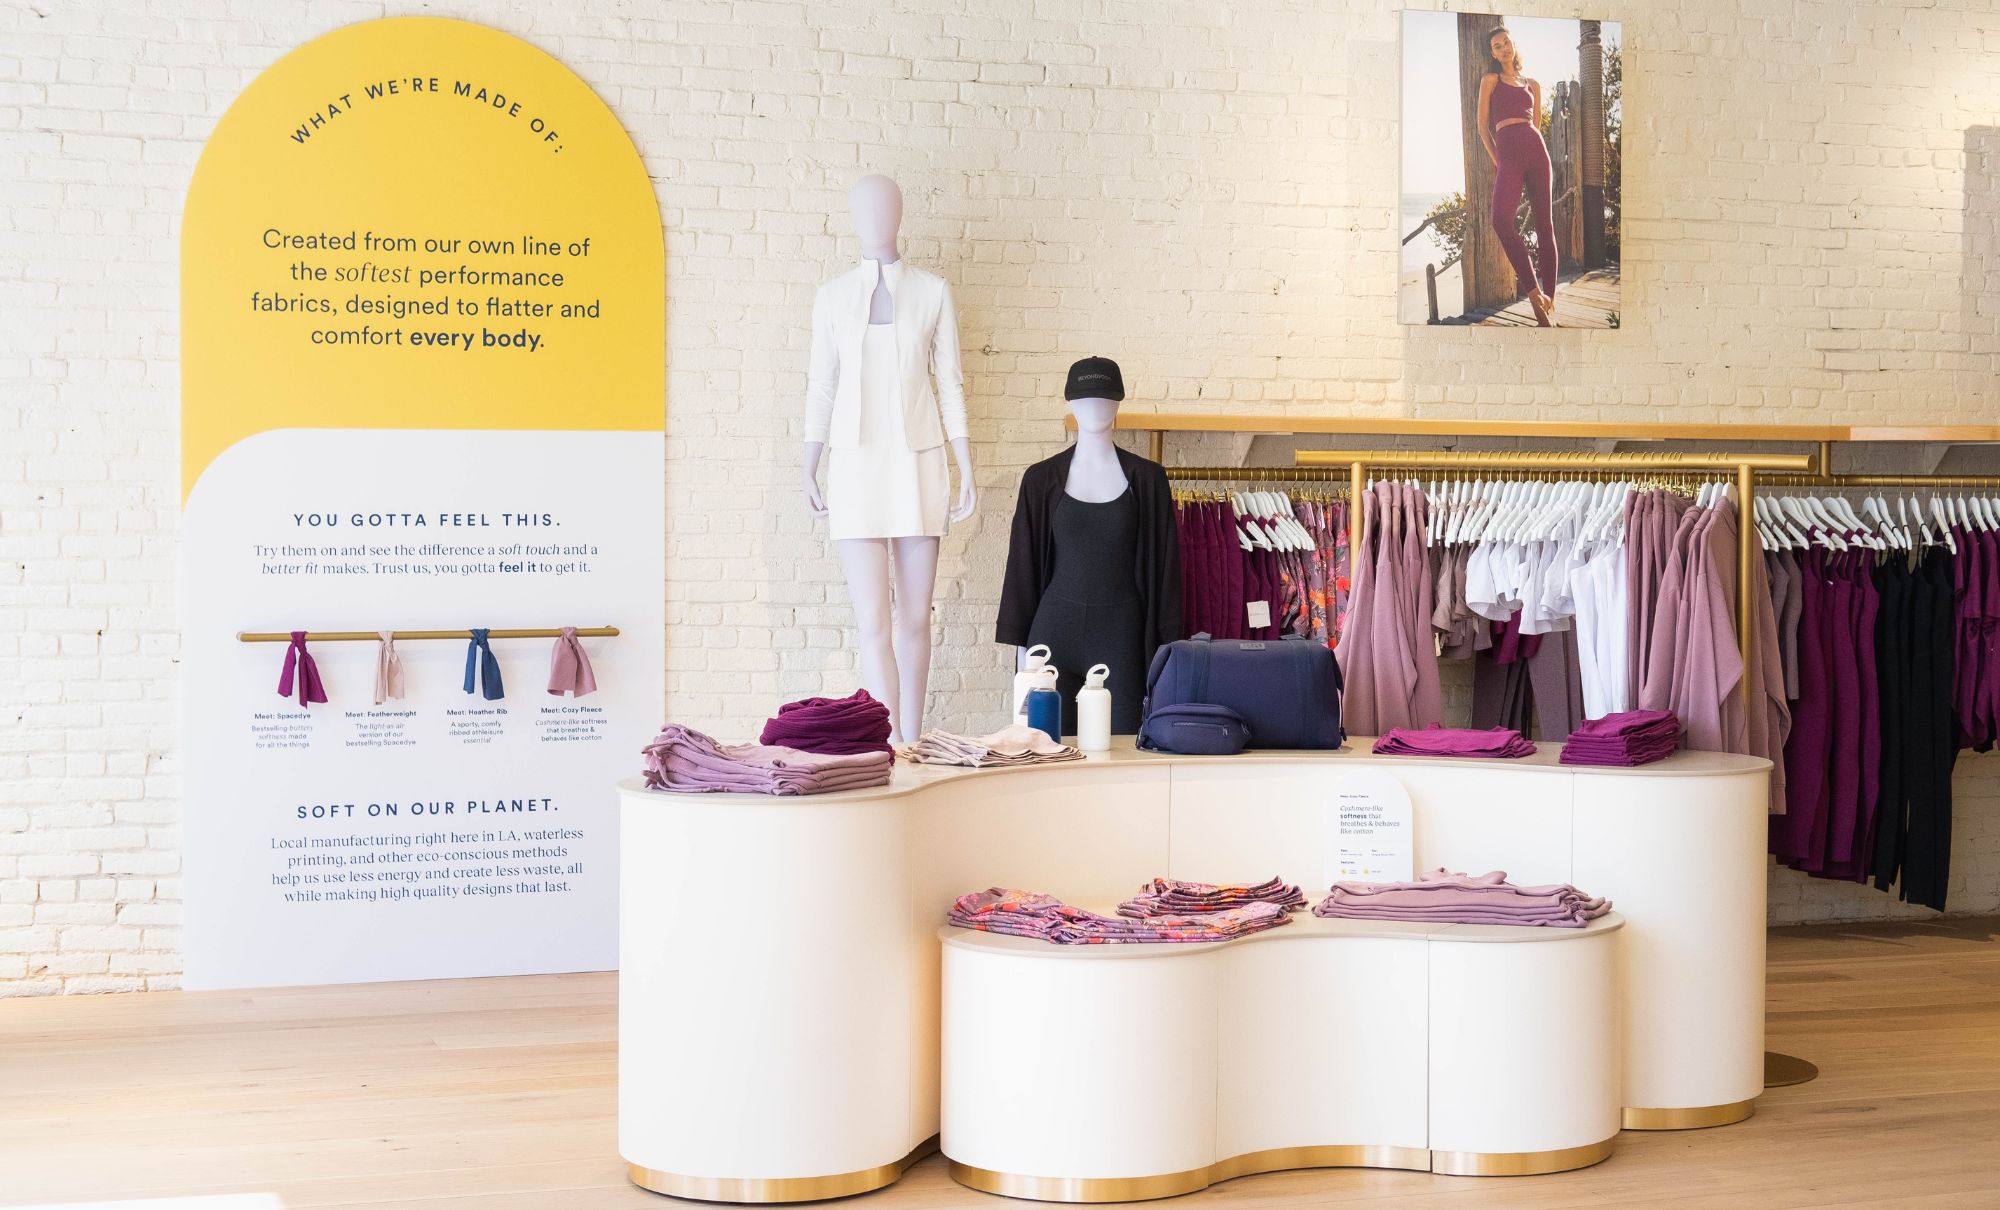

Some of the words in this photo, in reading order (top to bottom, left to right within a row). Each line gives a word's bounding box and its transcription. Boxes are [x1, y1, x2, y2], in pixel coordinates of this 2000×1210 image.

[291, 94, 351, 143] WHAT
[364, 78, 438, 99] WE'RE
[454, 81, 522, 117] MADE
[530, 119, 562, 153] OF:
[263, 229, 355, 250] Created
[364, 232, 416, 252] from
[425, 239, 461, 253] our
[469, 240, 514, 254] own
[524, 236, 561, 256] line
[569, 238, 590, 256] of
[290, 261, 327, 281] the
[335, 262, 412, 283] softest
[420, 265, 563, 288] performance
[252, 292, 337, 316] fabrics,
[346, 294, 448, 319] designed
[457, 299, 478, 316] to
[486, 297, 553, 317] flatter
[561, 299, 599, 318] and
[311, 326, 402, 345] comfort
[410, 332, 475, 351] every
[483, 328, 544, 352] body.
[294, 514, 337, 526] YOU
[351, 514, 426, 526] GOTTA
[440, 514, 489, 526] FEEL
[502, 514, 560, 526] THIS.
[254, 545, 277, 559] Try
[282, 545, 316, 556] them
[321, 548, 337, 556] on
[341, 545, 365, 556] and
[370, 547, 391, 556] see
[395, 544, 415, 555] the
[419, 544, 484, 555] difference
[488, 547, 495, 555] a
[498, 543, 522, 555] soft
[526, 544, 559, 555] touch
[564, 544, 587, 555] and
[591, 546, 597, 555] a
[262, 563, 301, 574] better
[306, 562, 318, 574] fit
[323, 563, 369, 574] makes.
[372, 563, 408, 573] Trust
[413, 565, 431, 574] us,
[435, 565, 457, 576] you
[462, 563, 495, 576] gotta
[499, 561, 523, 572] feel
[528, 561, 536, 572] it
[540, 562, 552, 572] to
[556, 562, 575, 575] get
[579, 561, 590, 572] it.
[368, 711, 416, 719] Featherweight
[562, 707, 579, 715] Cozy
[252, 725, 287, 733] Bestselling
[458, 721, 480, 730] sporty,
[346, 739, 381, 748] bestselling
[383, 739, 416, 747] Spacedye
[359, 731, 382, 739] version
[289, 741, 309, 749] things
[298, 805, 354, 818] SOFT
[368, 803, 397, 816] ON
[411, 802, 454, 815] OUR
[468, 799, 557, 813] PLANET.
[272, 837, 307, 848] Local
[312, 834, 411, 848] manufacturing
[416, 833, 447, 847] right
[451, 832, 478, 843] here
[482, 831, 494, 842] in
[498, 830, 520, 842] LA,
[524, 828, 583, 840] waterless
[289, 854, 346, 869] printing,
[350, 852, 374, 864] and
[378, 851, 413, 863] other
[417, 848, 508, 863] eco-conscious
[513, 846, 567, 858] methods
[272, 873, 300, 887] help
[304, 875, 319, 884] us
[324, 873, 345, 883] use
[350, 871, 375, 882] less
[378, 871, 422, 883] energy
[425, 866, 449, 879] and
[453, 867, 493, 878] create
[496, 865, 520, 878] less
[522, 865, 564, 875] waste,
[568, 862, 582, 874] all
[285, 890, 321, 902] while
[326, 888, 376, 902] making
[381, 886, 410, 901] high
[414, 885, 459, 900] quality
[463, 884, 512, 897] designs
[516, 882, 541, 893] that
[545, 881, 571, 892] last.
